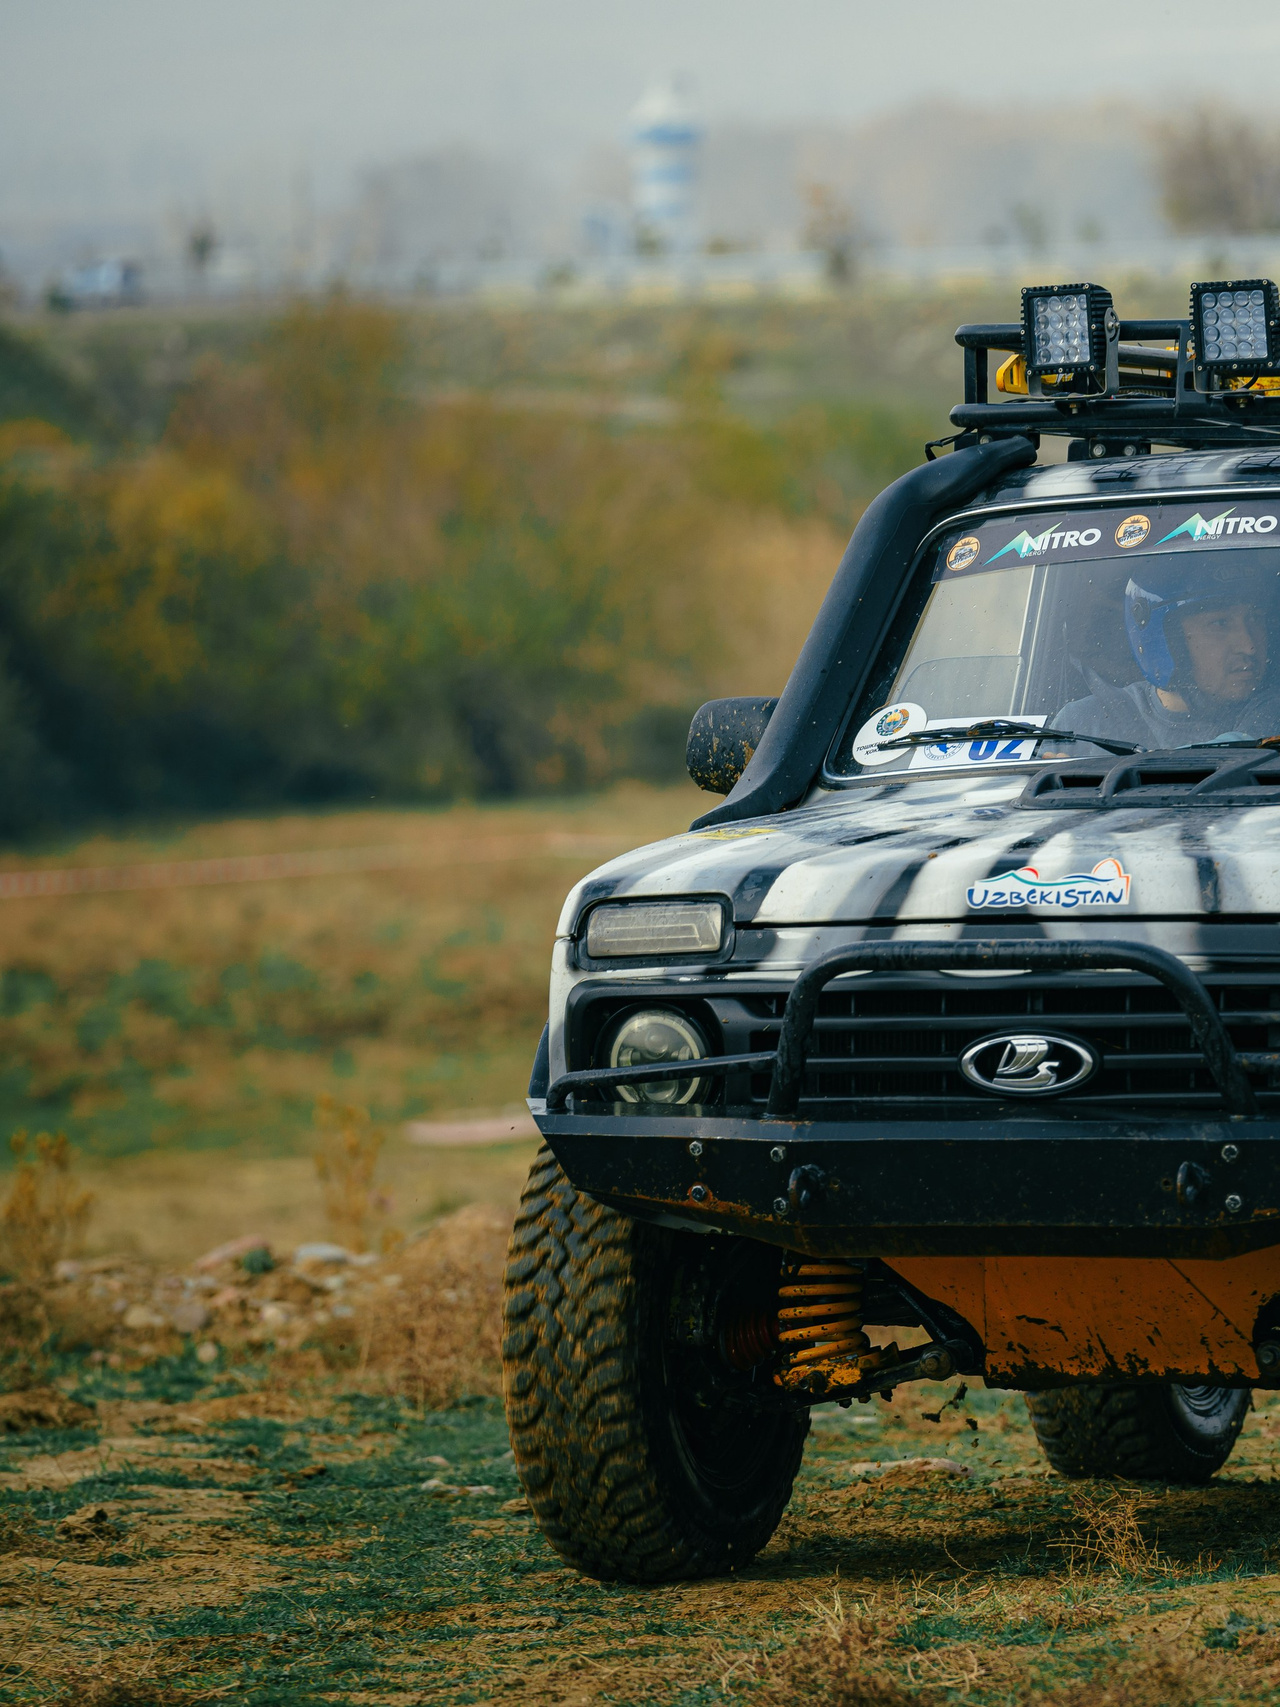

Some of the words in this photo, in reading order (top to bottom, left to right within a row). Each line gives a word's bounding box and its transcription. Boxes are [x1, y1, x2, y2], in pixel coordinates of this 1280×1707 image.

[1194, 515, 1278, 536] NITRO
[1021, 528, 1101, 553] NITRO
[967, 888, 1124, 909] UZBEKISTAN
